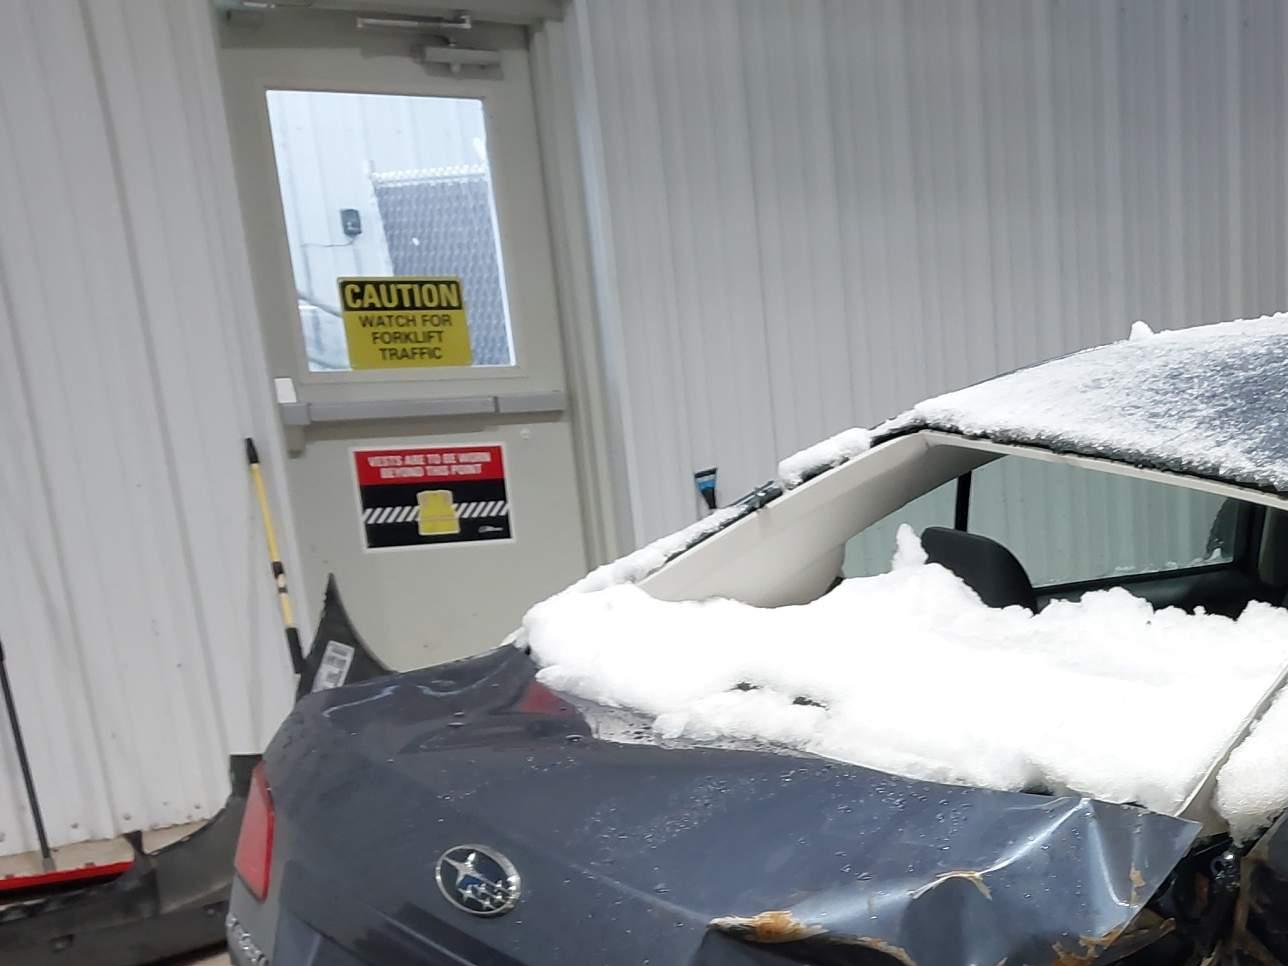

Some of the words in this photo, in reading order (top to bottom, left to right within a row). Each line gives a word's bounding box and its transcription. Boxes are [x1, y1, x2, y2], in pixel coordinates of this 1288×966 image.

[344, 283, 459, 308] CAUTION
[359, 314, 417, 328] WATCH
[421, 314, 453, 328] FOR
[371, 330, 444, 344] FORKLIFT
[378, 347, 443, 360] TRAFFIC
